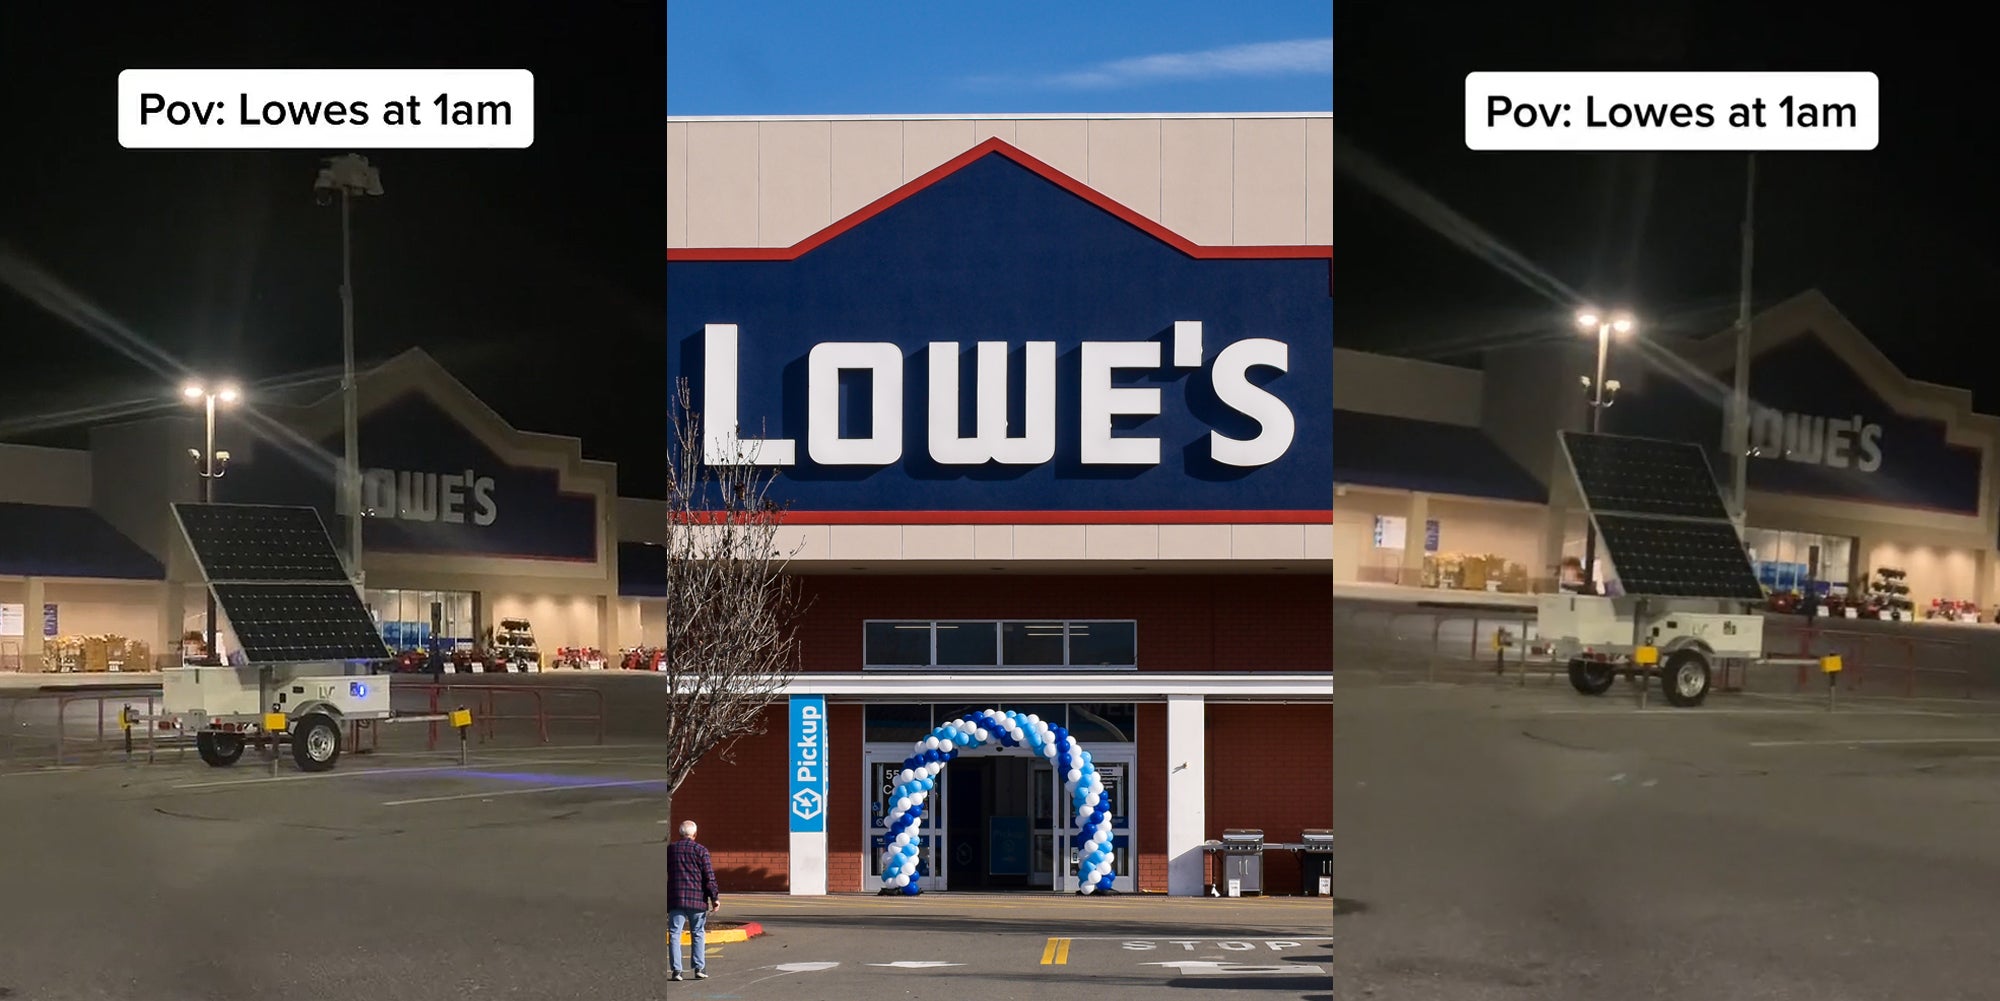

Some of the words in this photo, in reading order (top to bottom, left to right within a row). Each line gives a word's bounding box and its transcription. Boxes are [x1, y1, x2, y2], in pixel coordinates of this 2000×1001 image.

[704, 320, 1295, 467] LOWE'S
[797, 705, 822, 782] Pickup
[1122, 940, 1302, 951] STOP
